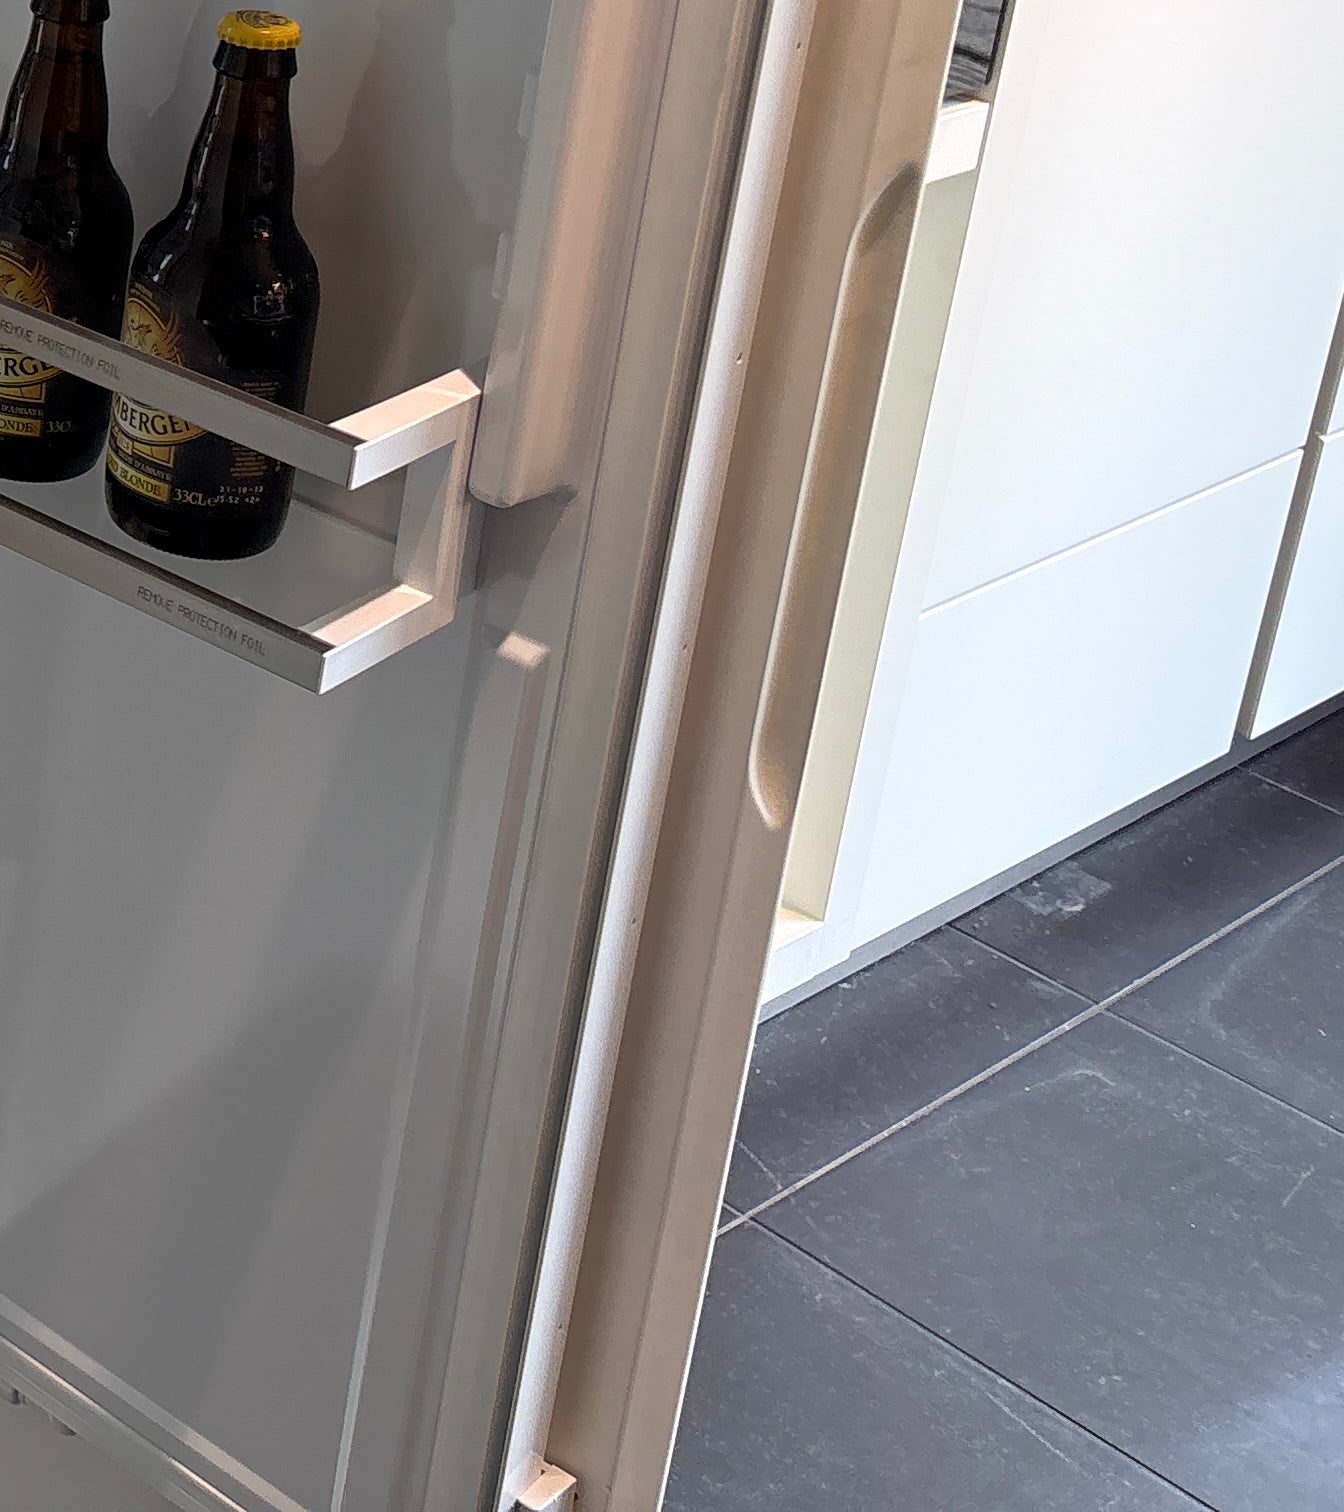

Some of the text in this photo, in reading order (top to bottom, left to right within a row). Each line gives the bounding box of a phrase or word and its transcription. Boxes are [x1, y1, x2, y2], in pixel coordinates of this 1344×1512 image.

[37, 334, 94, 369] PROTECTION
[119, 468, 162, 496] BLONDE
[173, 488, 207, 506] 33CL
[136, 585, 266, 656] REMOVE PROTECTION FOIL
